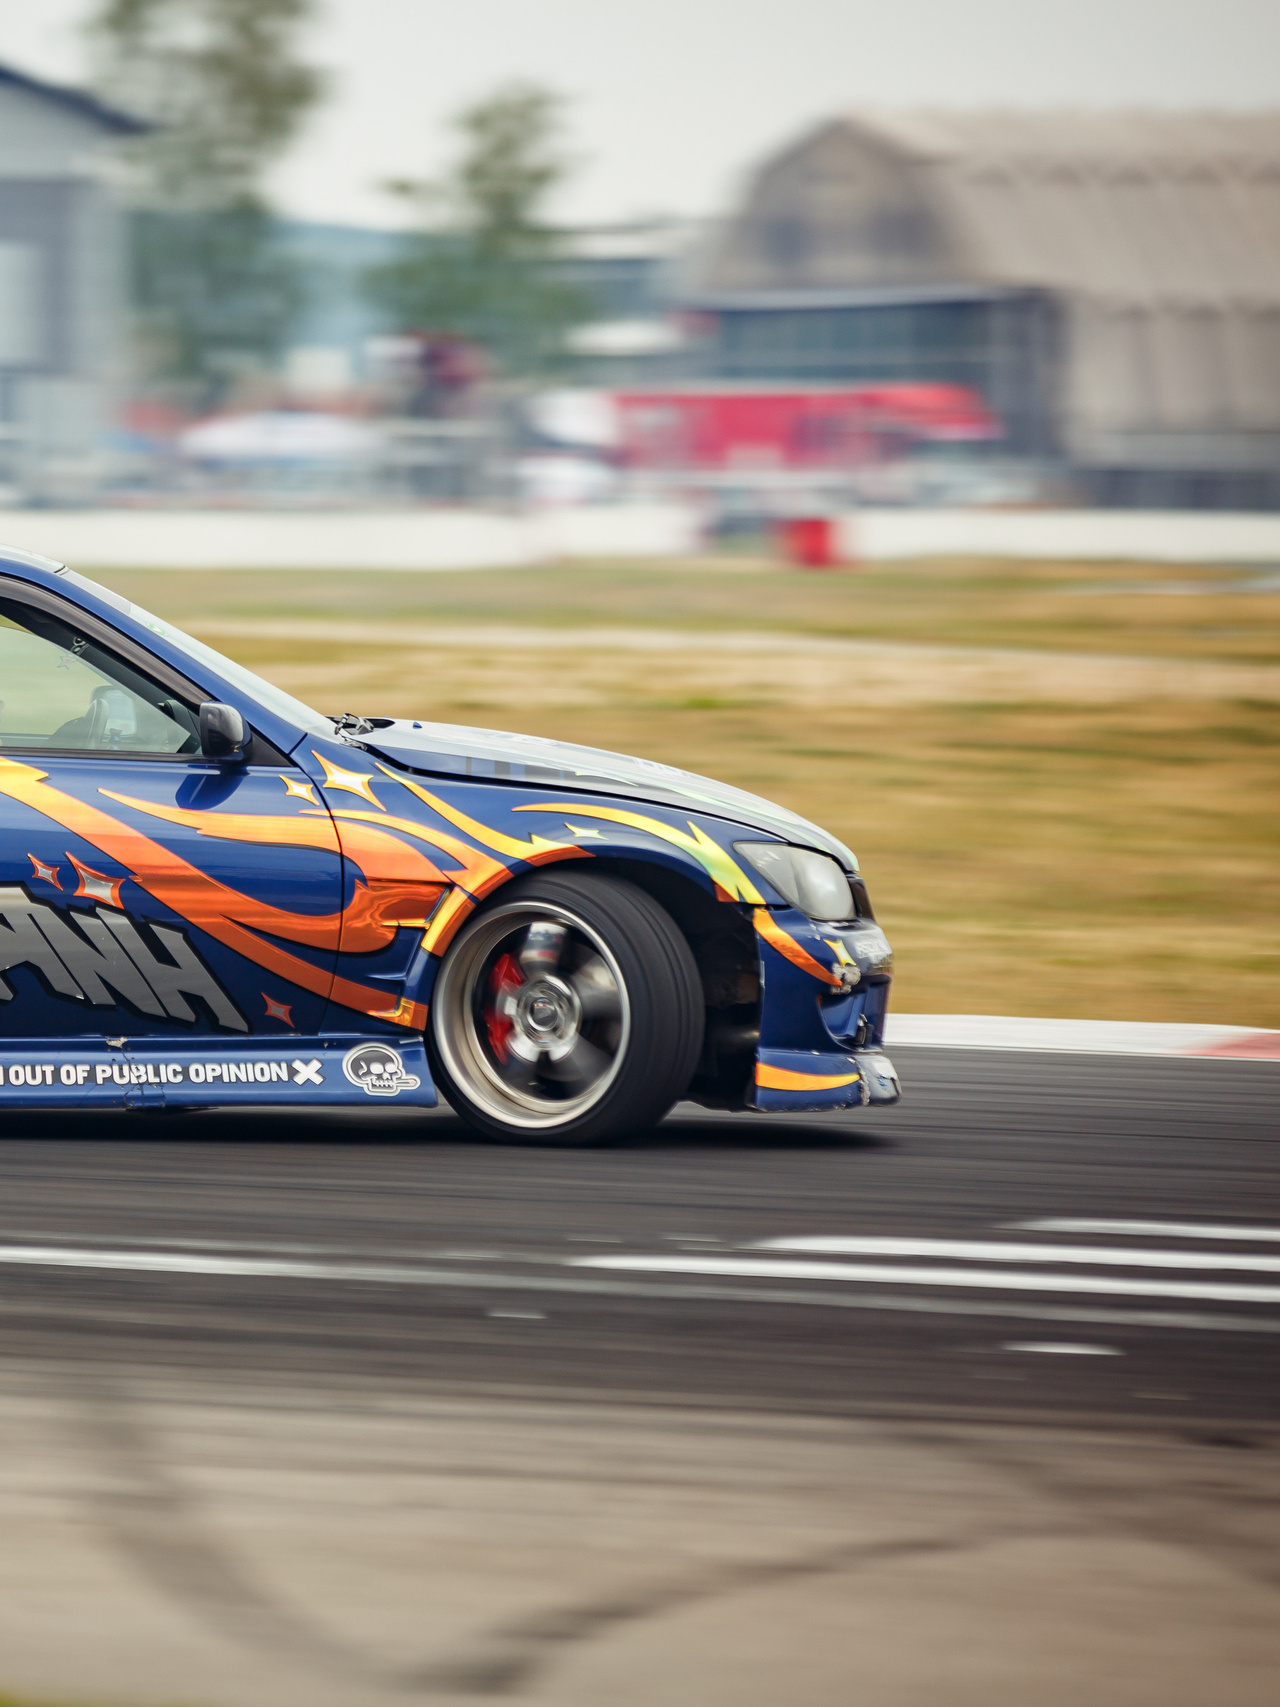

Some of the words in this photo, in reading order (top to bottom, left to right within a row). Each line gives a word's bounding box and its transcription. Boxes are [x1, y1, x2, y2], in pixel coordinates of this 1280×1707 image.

[8, 1063, 55, 1087] OUT
[60, 1063, 91, 1086] OF
[95, 1062, 184, 1086] PUBLIC
[188, 1060, 289, 1084] OPINION
